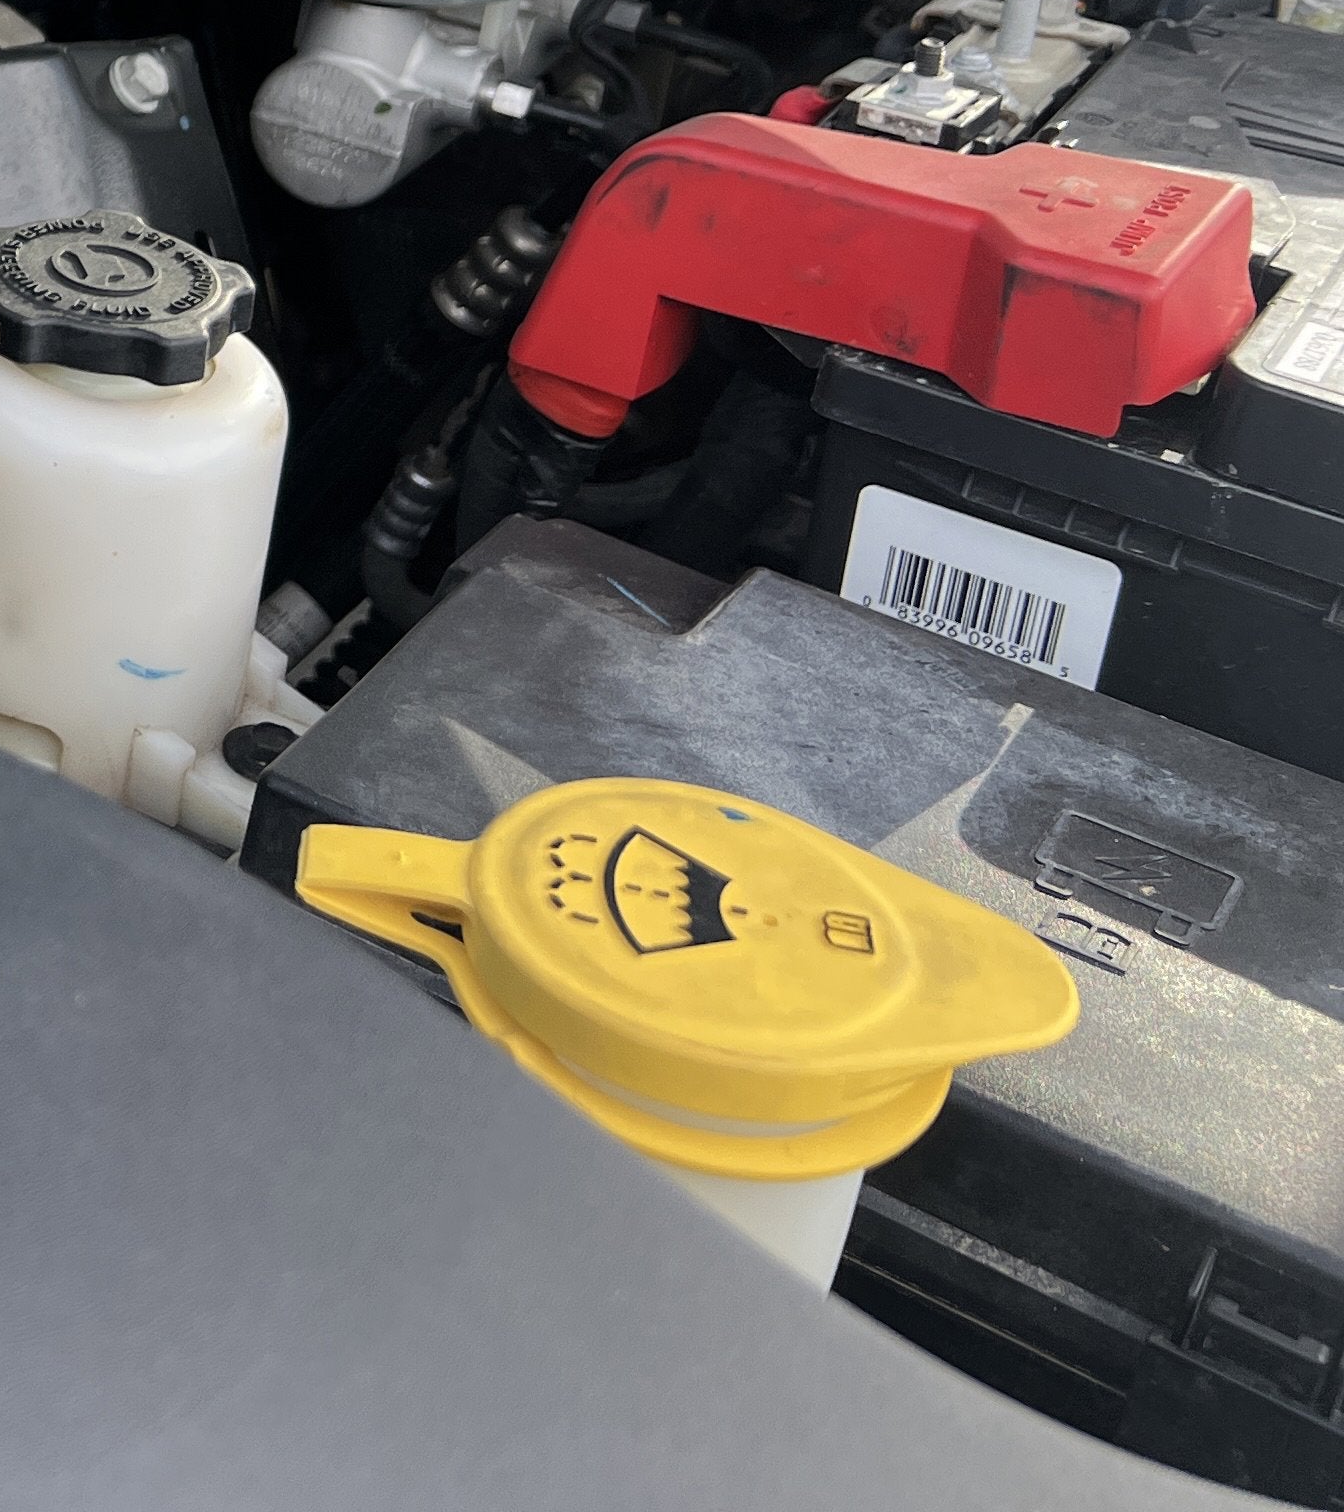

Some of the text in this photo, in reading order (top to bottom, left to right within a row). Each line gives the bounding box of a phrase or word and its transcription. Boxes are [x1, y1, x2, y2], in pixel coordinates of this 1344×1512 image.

[71, 299, 152, 319] FLUID
[862, 594, 1070, 679] 0 83996 09658 5
